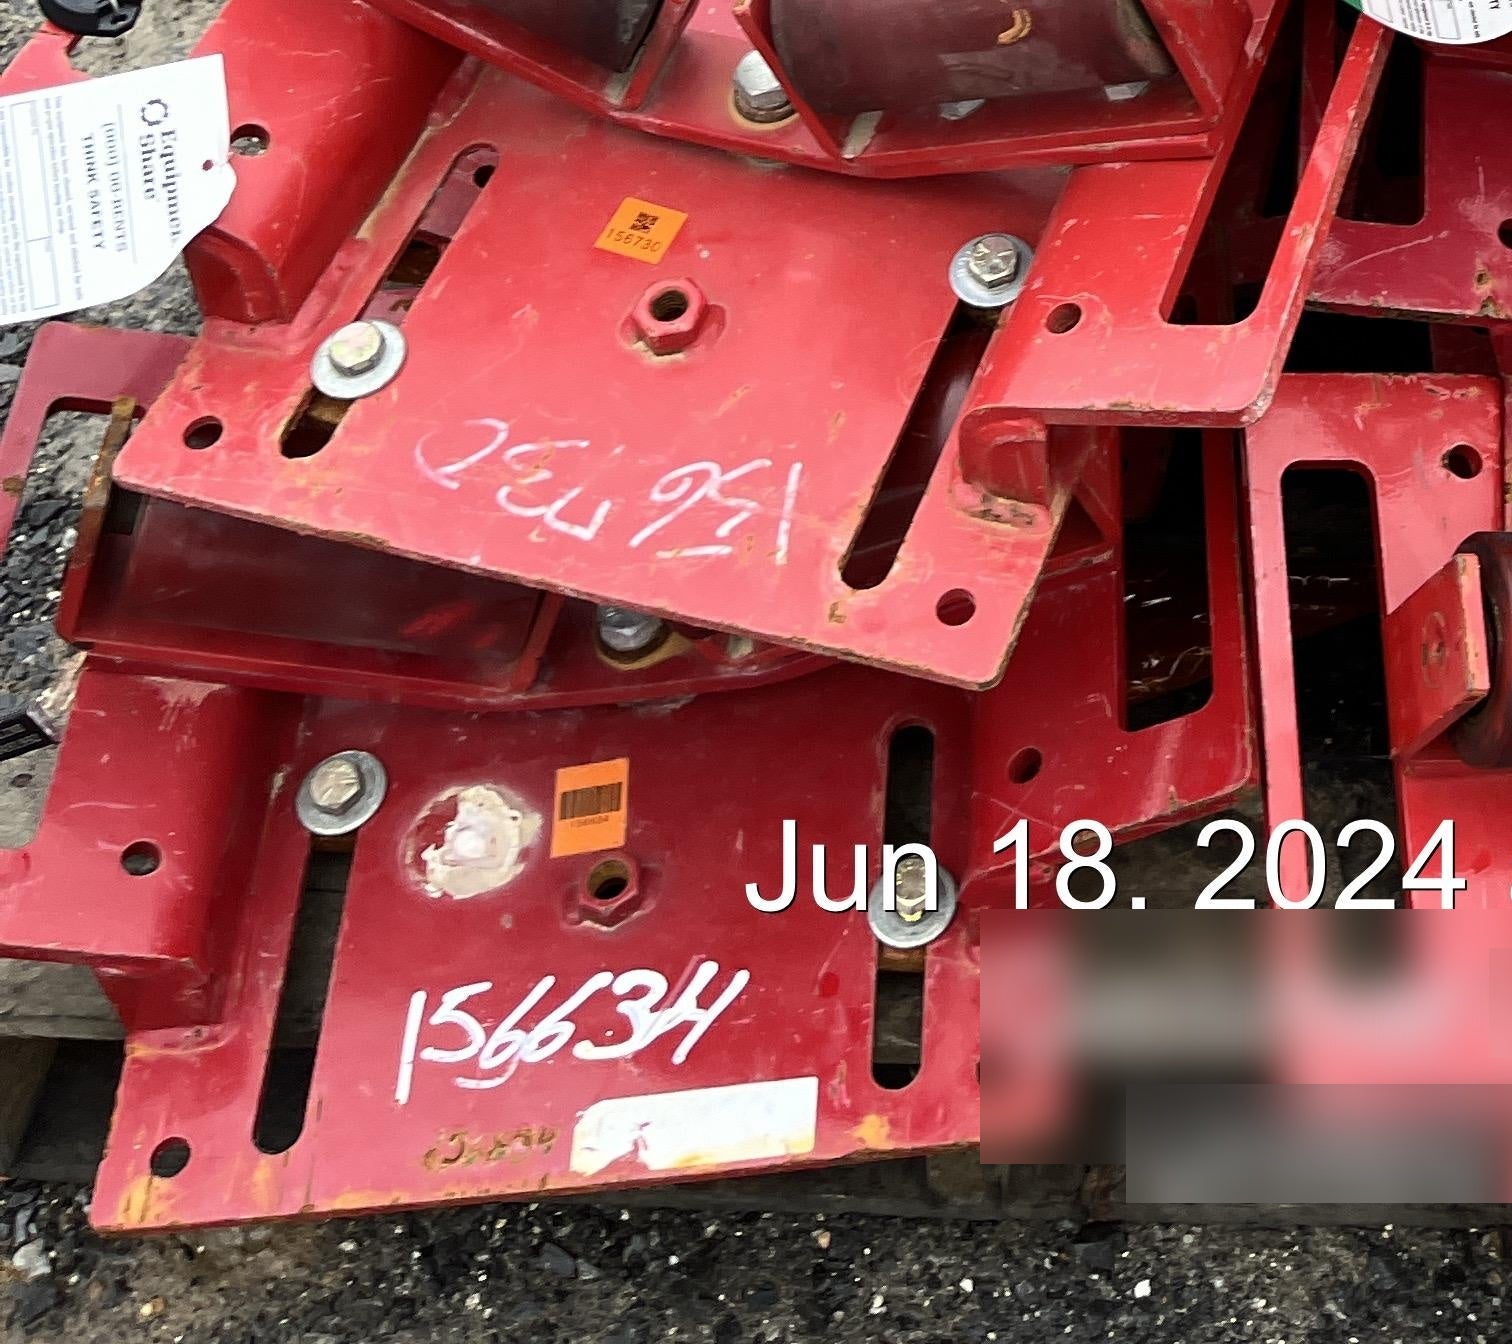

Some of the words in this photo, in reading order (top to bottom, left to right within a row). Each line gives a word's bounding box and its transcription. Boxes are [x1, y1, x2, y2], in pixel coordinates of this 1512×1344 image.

[82, 135, 97, 184] THINK
[140, 134, 156, 199] Share
[88, 189, 106, 249] SAFETY
[606, 228, 661, 252] 156730
[394, 960, 751, 1106] 156634
